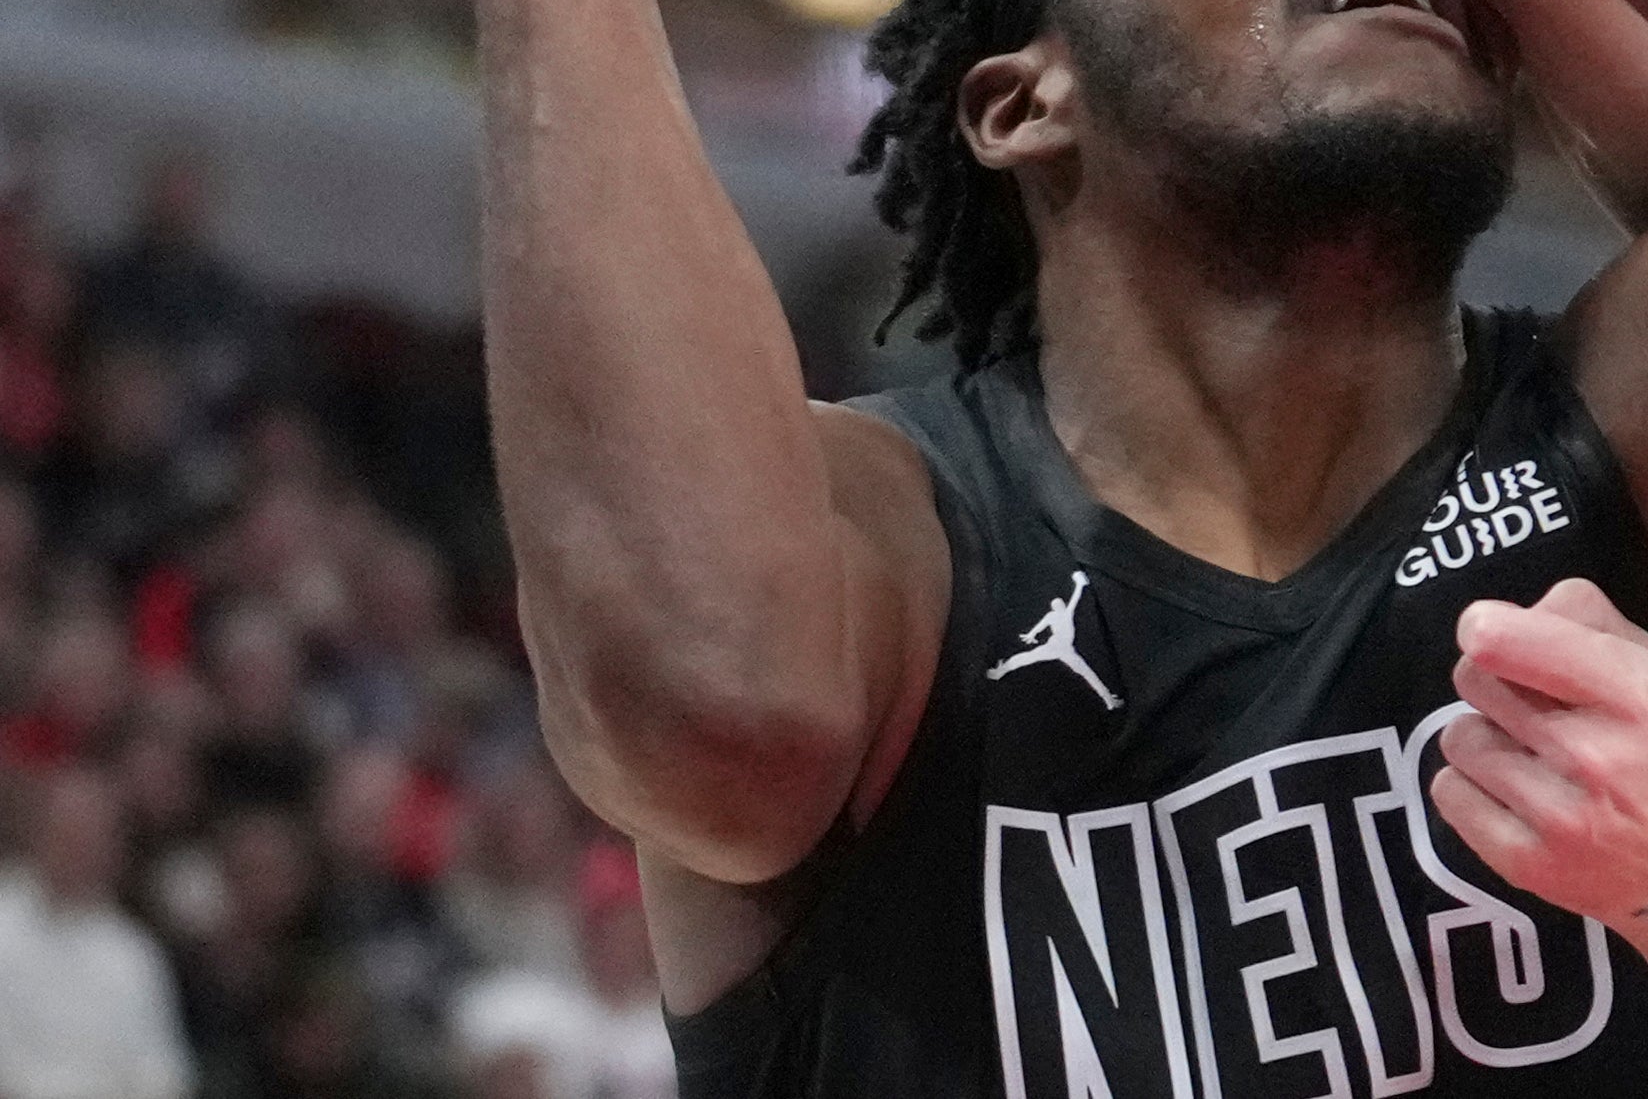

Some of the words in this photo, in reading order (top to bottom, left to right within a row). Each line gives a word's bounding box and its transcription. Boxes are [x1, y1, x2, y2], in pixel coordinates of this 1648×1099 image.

[1395, 487, 1570, 587] GUIDE
[1422, 460, 1545, 532] OUR
[984, 699, 1615, 1099] NETS
